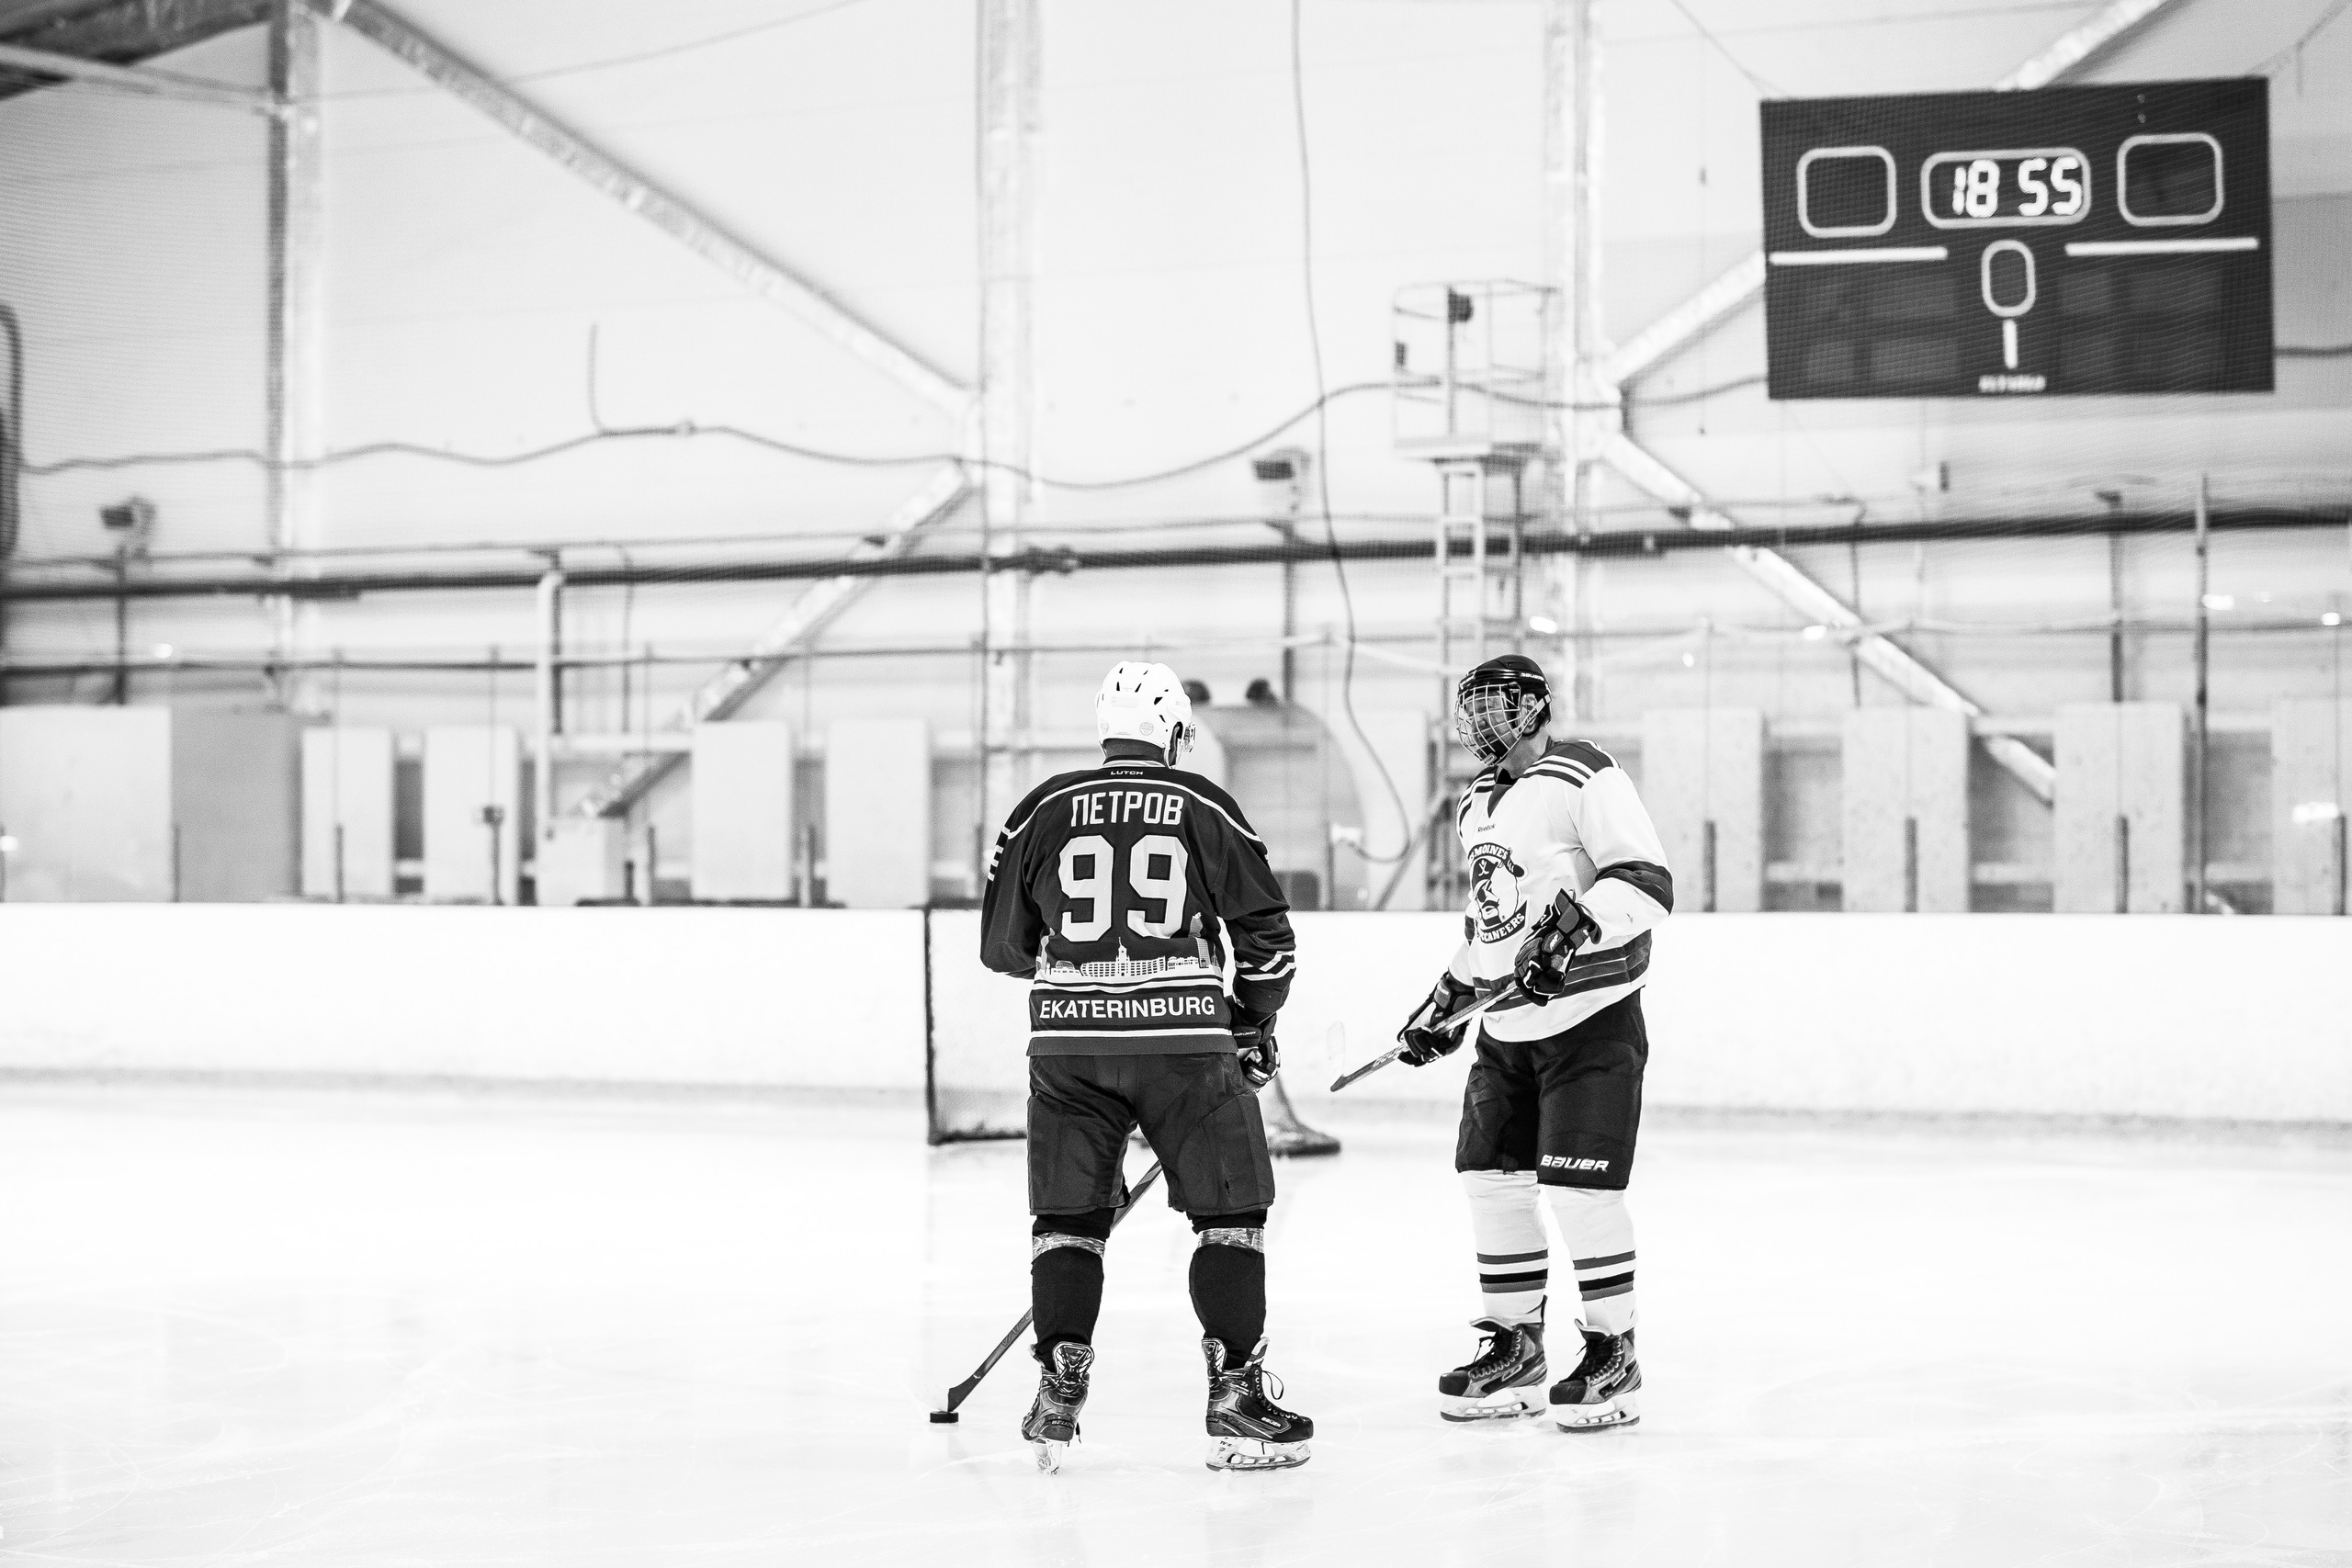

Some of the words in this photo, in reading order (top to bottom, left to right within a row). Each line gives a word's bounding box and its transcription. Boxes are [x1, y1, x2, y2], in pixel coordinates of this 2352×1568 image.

[1951, 159, 2000, 219] 18
[2018, 156, 2083, 217] 55
[1070, 790, 1185, 828] ПЕТРОВ
[1474, 843, 1509, 860] MOINES
[1057, 834, 1189, 942] 99
[1479, 912, 1525, 942] CCANEERS
[1039, 996, 1216, 1019] EKATERINBURG
[1540, 1154, 1610, 1173] BAUER
